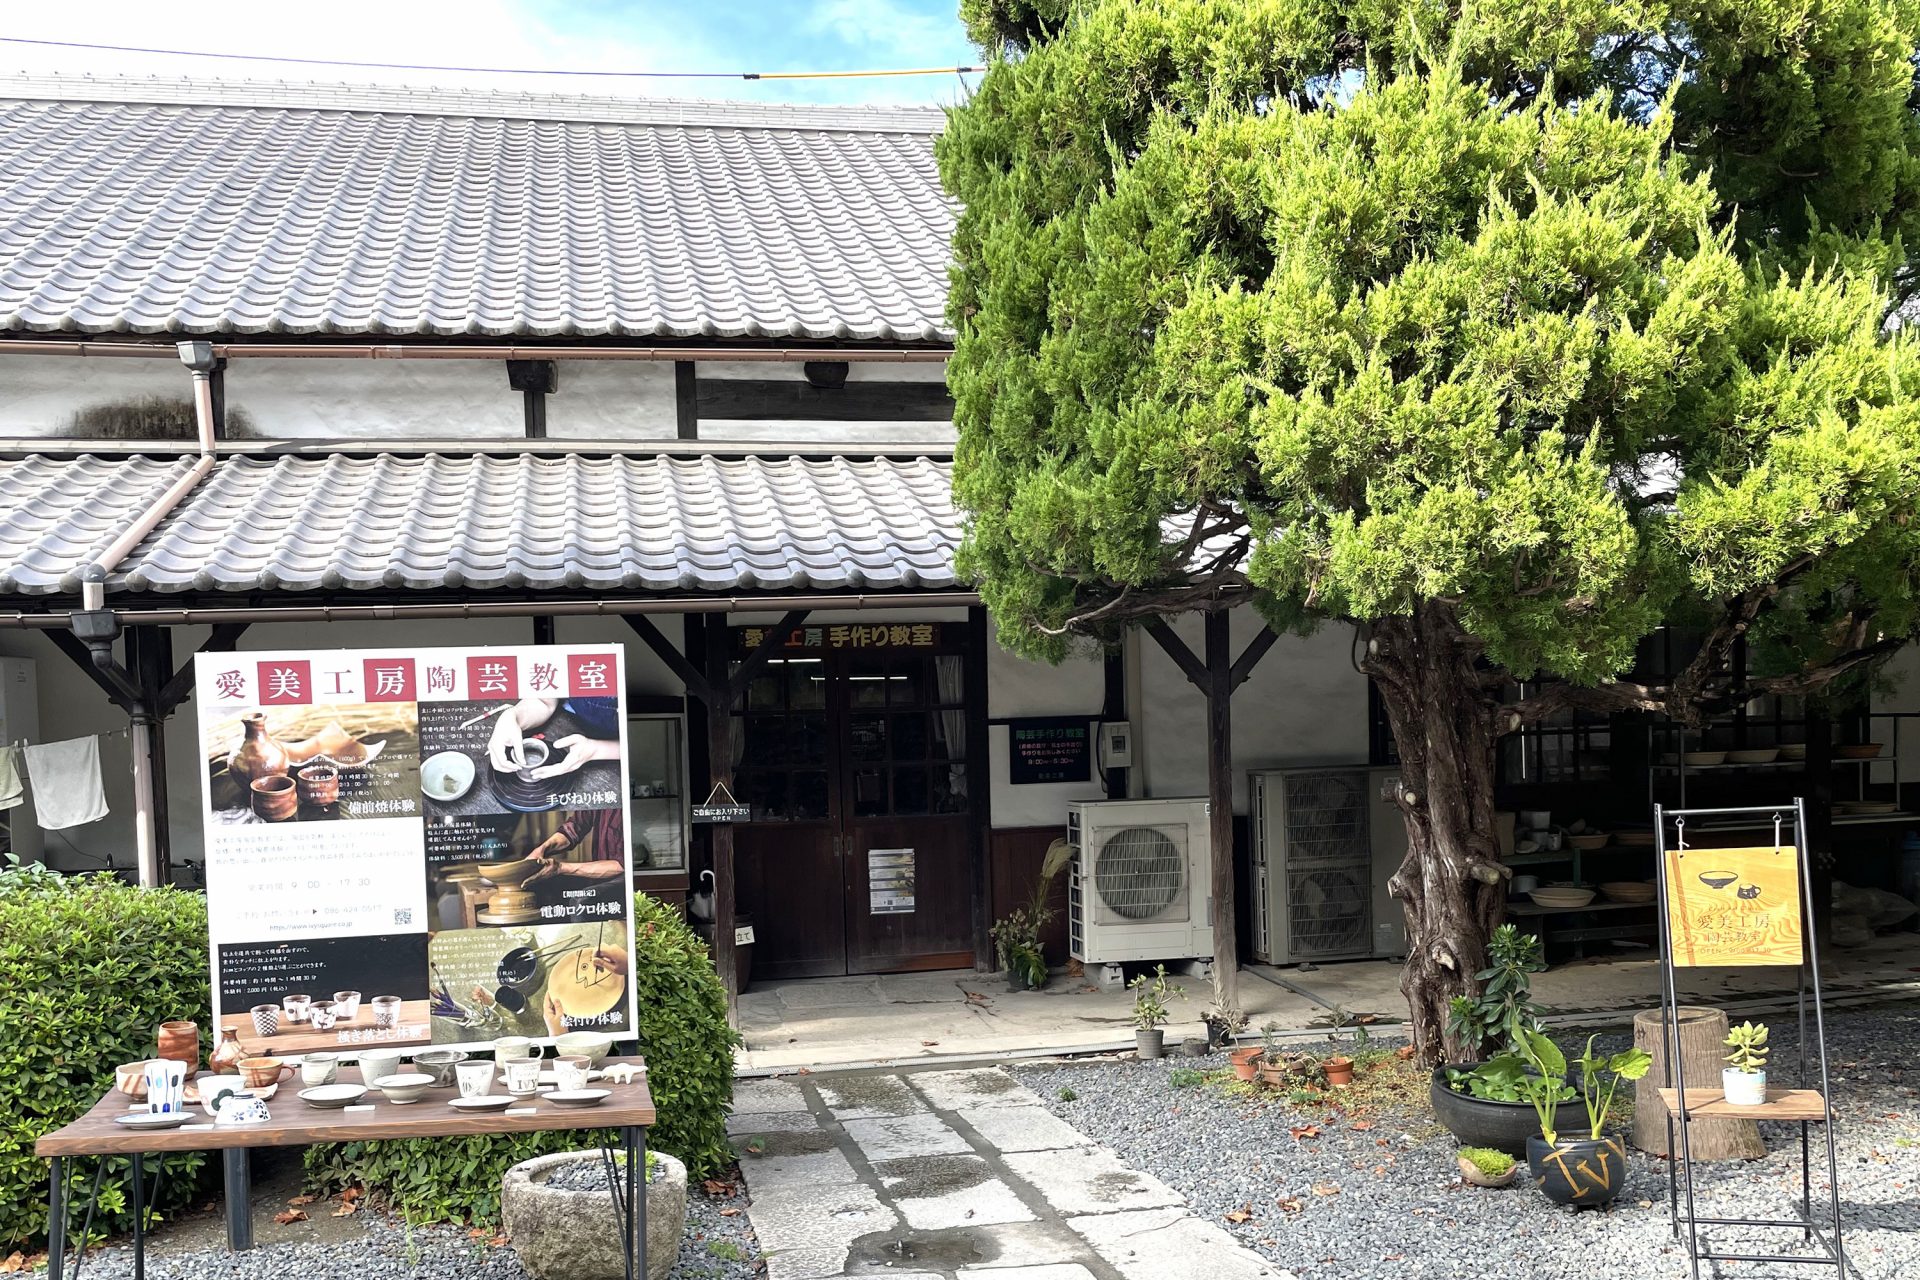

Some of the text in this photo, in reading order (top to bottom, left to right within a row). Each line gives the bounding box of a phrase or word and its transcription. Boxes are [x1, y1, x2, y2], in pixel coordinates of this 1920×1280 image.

[829, 624, 934, 648] 手作り教室
[215, 660, 609, 700] 愛美工房陶芸教室
[348, 798, 416, 814] 備前焼体験
[546, 791, 618, 806] 手びねり体験
[693, 808, 750, 816] ご自由にお入り下さい
[540, 901, 621, 918] 電動ロクロ体験
[1697, 914, 1771, 930] 愛美工房
[560, 1011, 623, 1027] 絵付け体験
[337, 1026, 423, 1043] 掻き落とし体験
